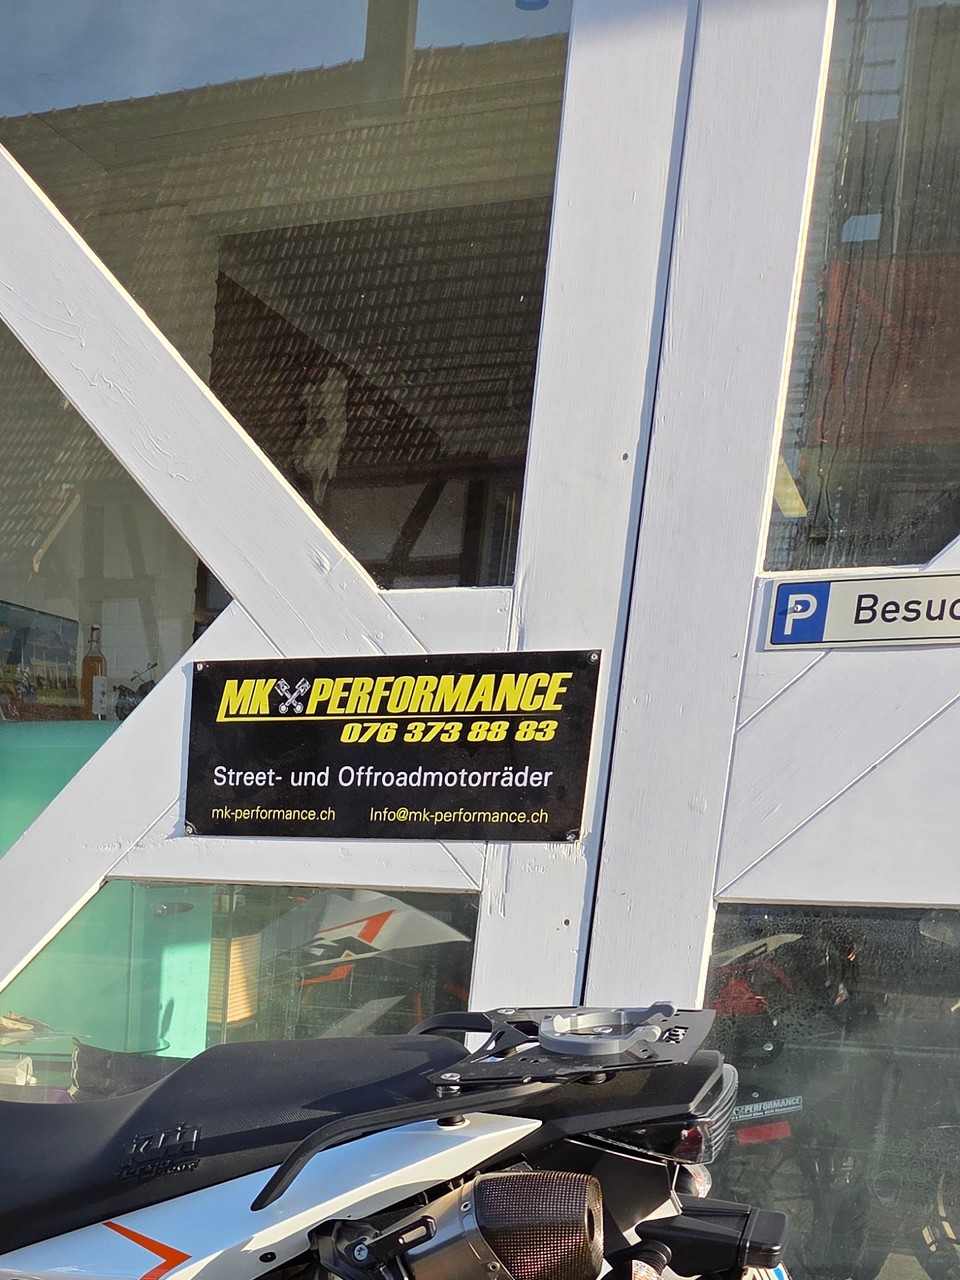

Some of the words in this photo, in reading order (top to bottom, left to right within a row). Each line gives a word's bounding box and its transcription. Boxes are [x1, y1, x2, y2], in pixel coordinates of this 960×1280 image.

[218, 678, 278, 717] MK
[305, 672, 573, 715] PERFORMANCE
[341, 723, 399, 743] 076
[404, 722, 461, 743] 373
[467, 721, 510, 742] 88
[514, 720, 558, 742] 83
[213, 765, 283, 788] Street-
[290, 766, 329, 788] und
[338, 765, 553, 788] Offroadmotorräder
[211, 806, 336, 822] mk-performance.ch
[369, 807, 549, 825] Info@mk-performance.ch
